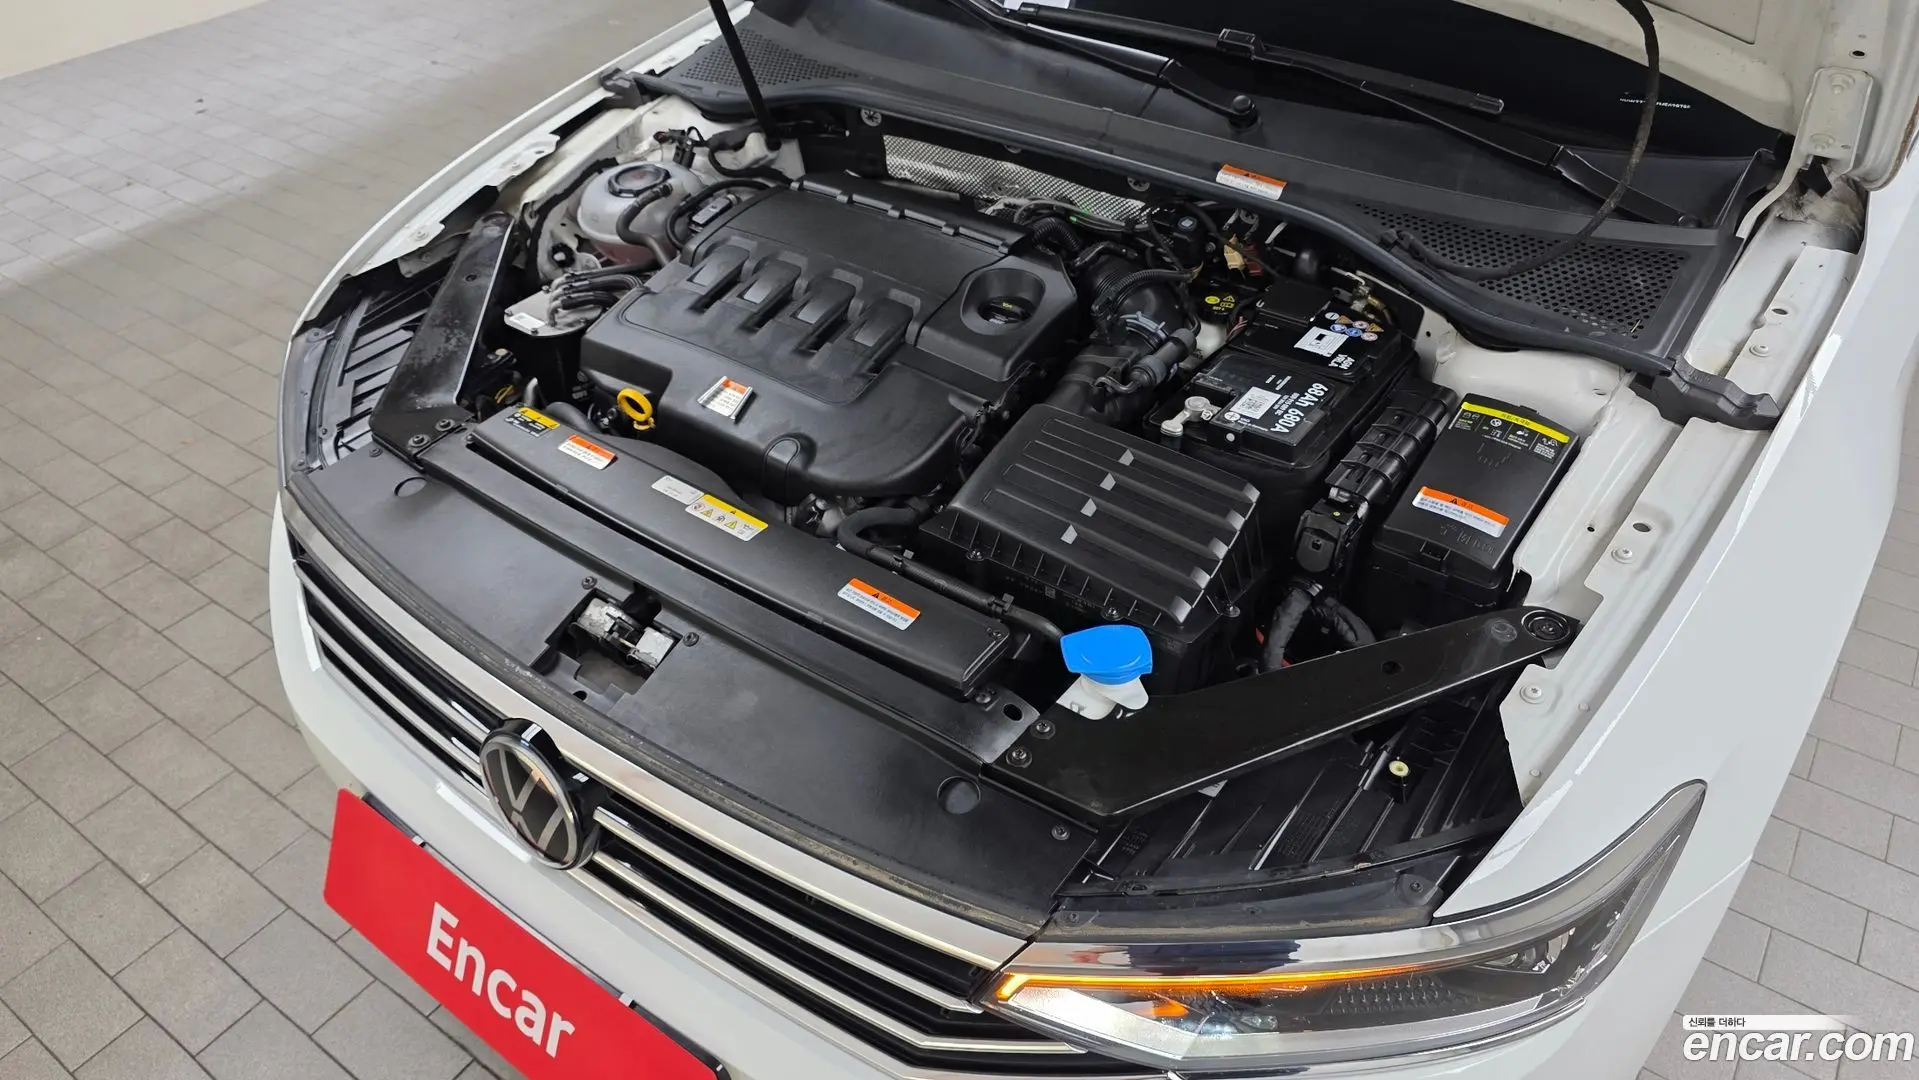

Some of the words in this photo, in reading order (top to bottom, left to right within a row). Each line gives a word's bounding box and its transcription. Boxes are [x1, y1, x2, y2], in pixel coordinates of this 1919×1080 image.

[1295, 383, 1328, 407] 68Ah
[1270, 408, 1304, 432] 680A
[427, 901, 576, 1058] Encar
